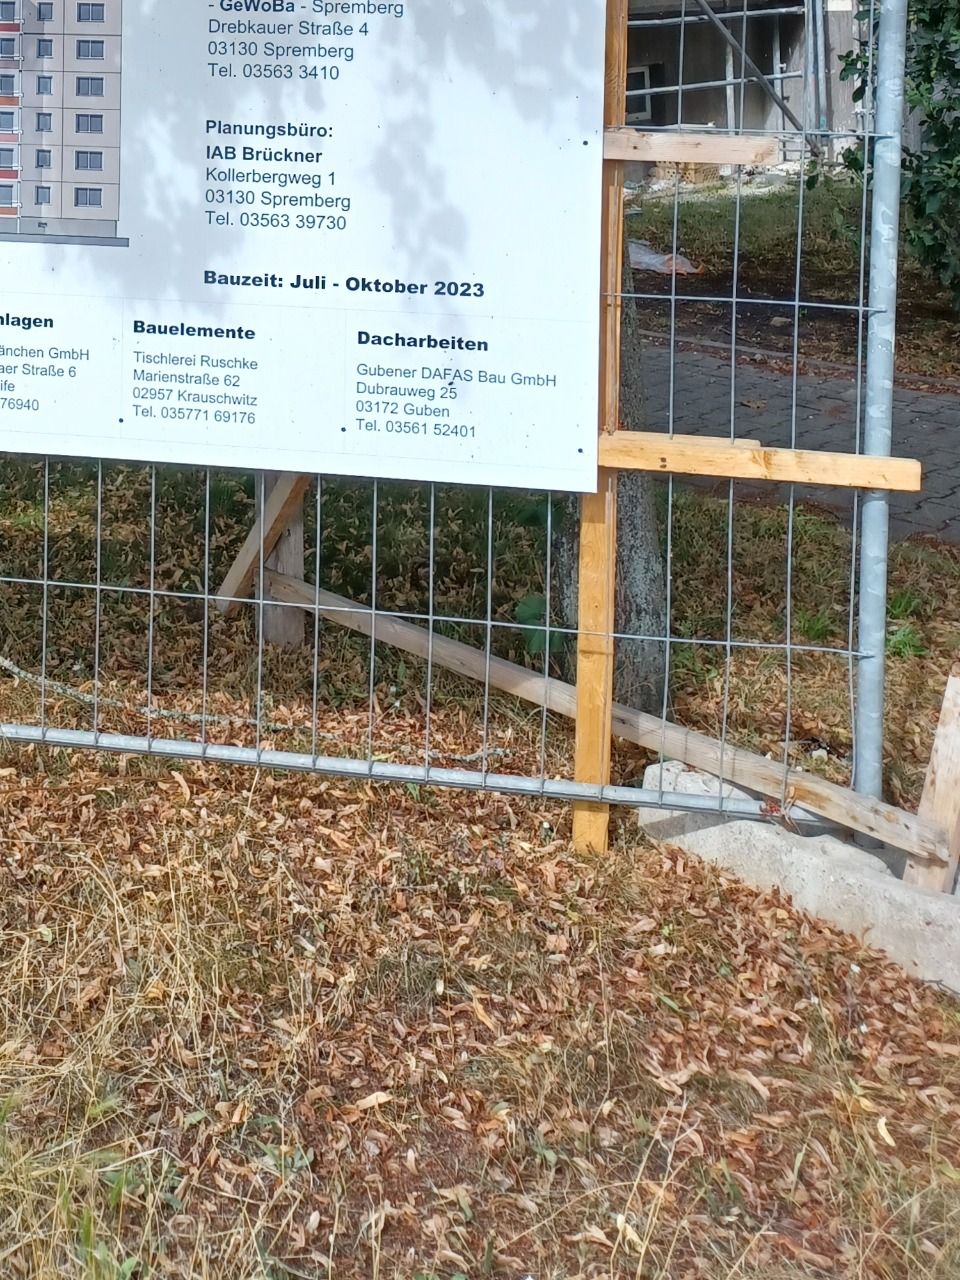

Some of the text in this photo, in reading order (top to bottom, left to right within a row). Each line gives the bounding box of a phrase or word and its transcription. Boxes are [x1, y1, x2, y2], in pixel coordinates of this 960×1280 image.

[311, 0, 404, 17] Spremberg
[208, 19, 369, 36] Drebkauer Straße 4
[207, 41, 354, 61] 03130 Spremberg
[208, 63, 340, 80] Tel. 03563 3410
[205, 120, 334, 140] Planungsbüro:
[205, 146, 323, 164] IAB Brückner
[205, 167, 335, 188] Kollerbergweg 1
[205, 189, 351, 211] 03130 Spremberg
[205, 211, 346, 230] Tel. 03563 39730
[204, 270, 283, 288] Bauzeit:
[289, 274, 327, 290] Juli
[345, 277, 428, 295] Oktober
[434, 281, 485, 297] 2023
[133, 320, 256, 340] Bauelemente
[357, 331, 489, 352] Dacharbeiten
[48, 347, 90, 360] GmbH
[133, 351, 259, 370] Tischlerei Ruschke
[21, 362, 65, 377] Straße
[68, 365, 77, 378] 6
[132, 369, 240, 387] Marienstraße 62
[356, 364, 557, 388] Gubener DAFAS Bau GmbH
[132, 387, 258, 407] 02957 Krauschwitz
[356, 381, 458, 400] Dubrauweg 25
[0, 396, 40, 411] 76940
[356, 400, 450, 418] 03172 Guben
[132, 404, 256, 425] Tel. 035771 69176
[356, 418, 476, 438] Tel. 03561 52401
